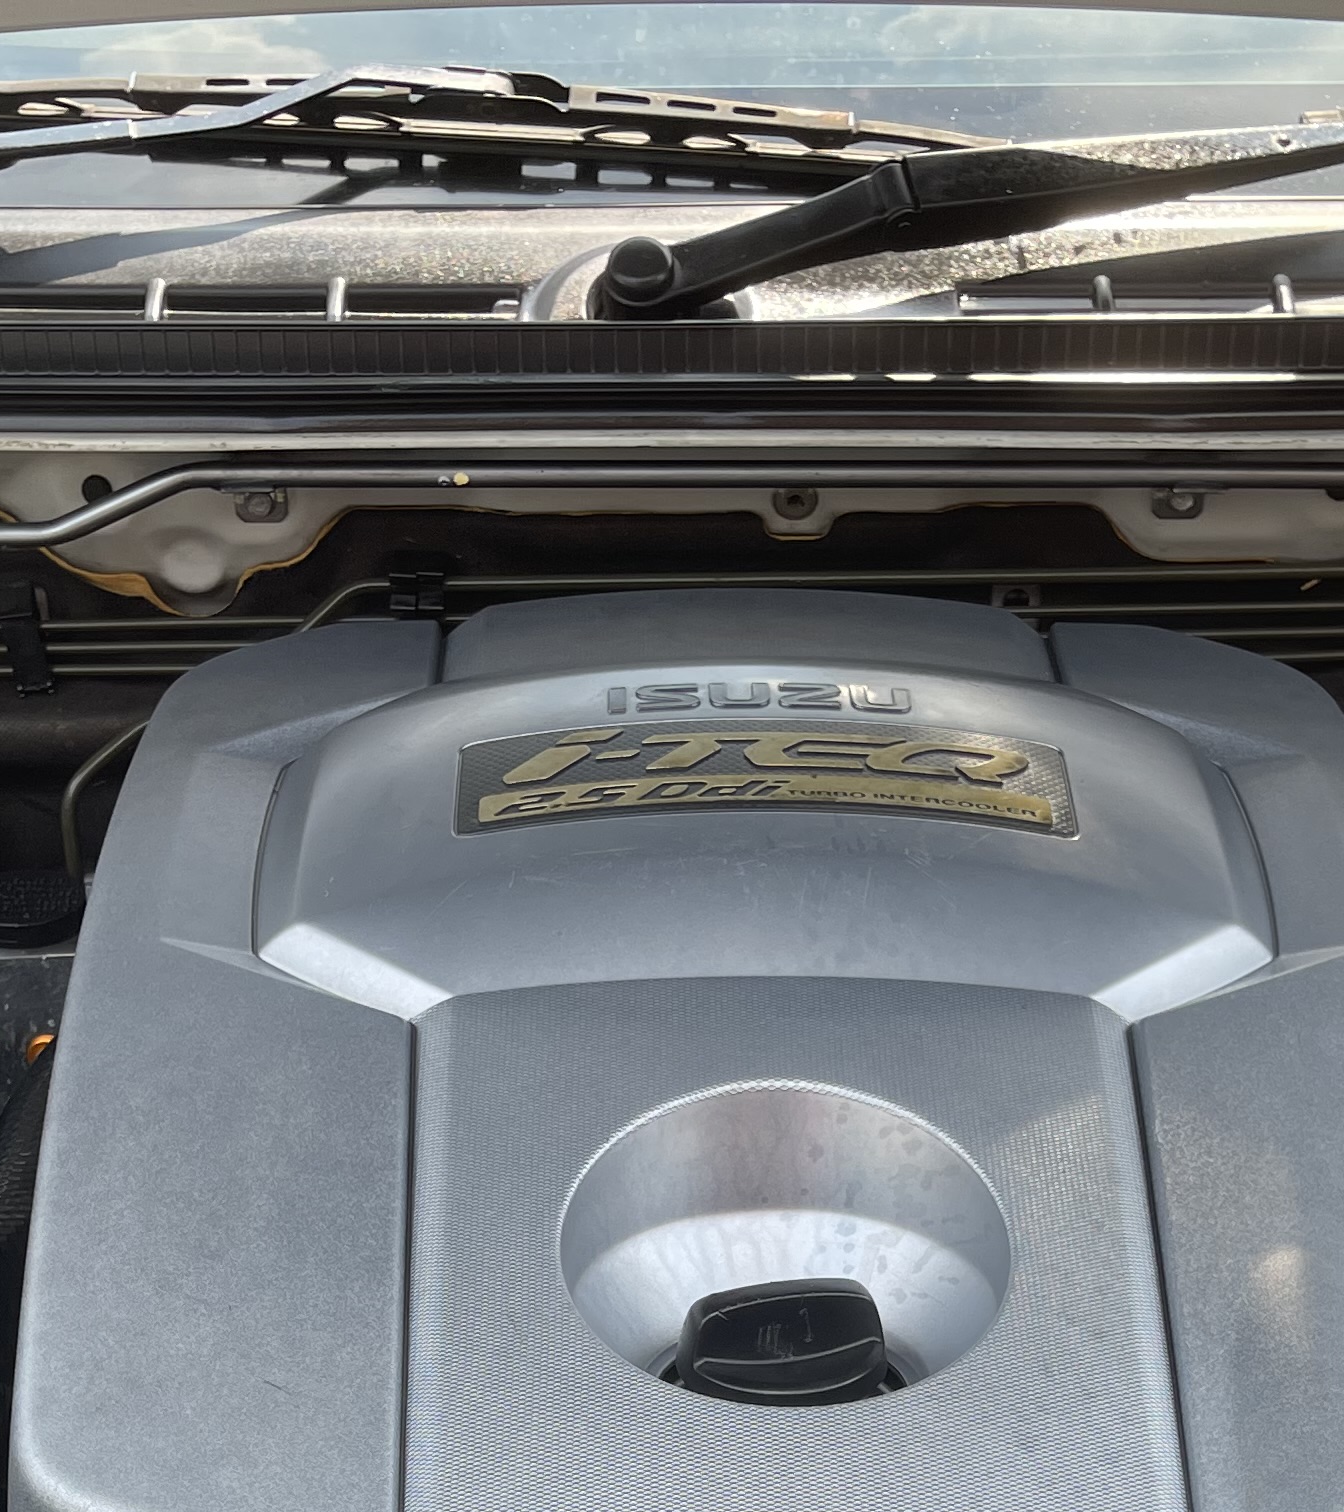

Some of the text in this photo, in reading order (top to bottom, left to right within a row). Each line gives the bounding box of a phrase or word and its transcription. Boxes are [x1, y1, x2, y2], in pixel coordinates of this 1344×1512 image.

[607, 682, 911, 715] ISUZU
[787, 788, 866, 799] TURBO
[873, 792, 1037, 818] INTERCOOLER
